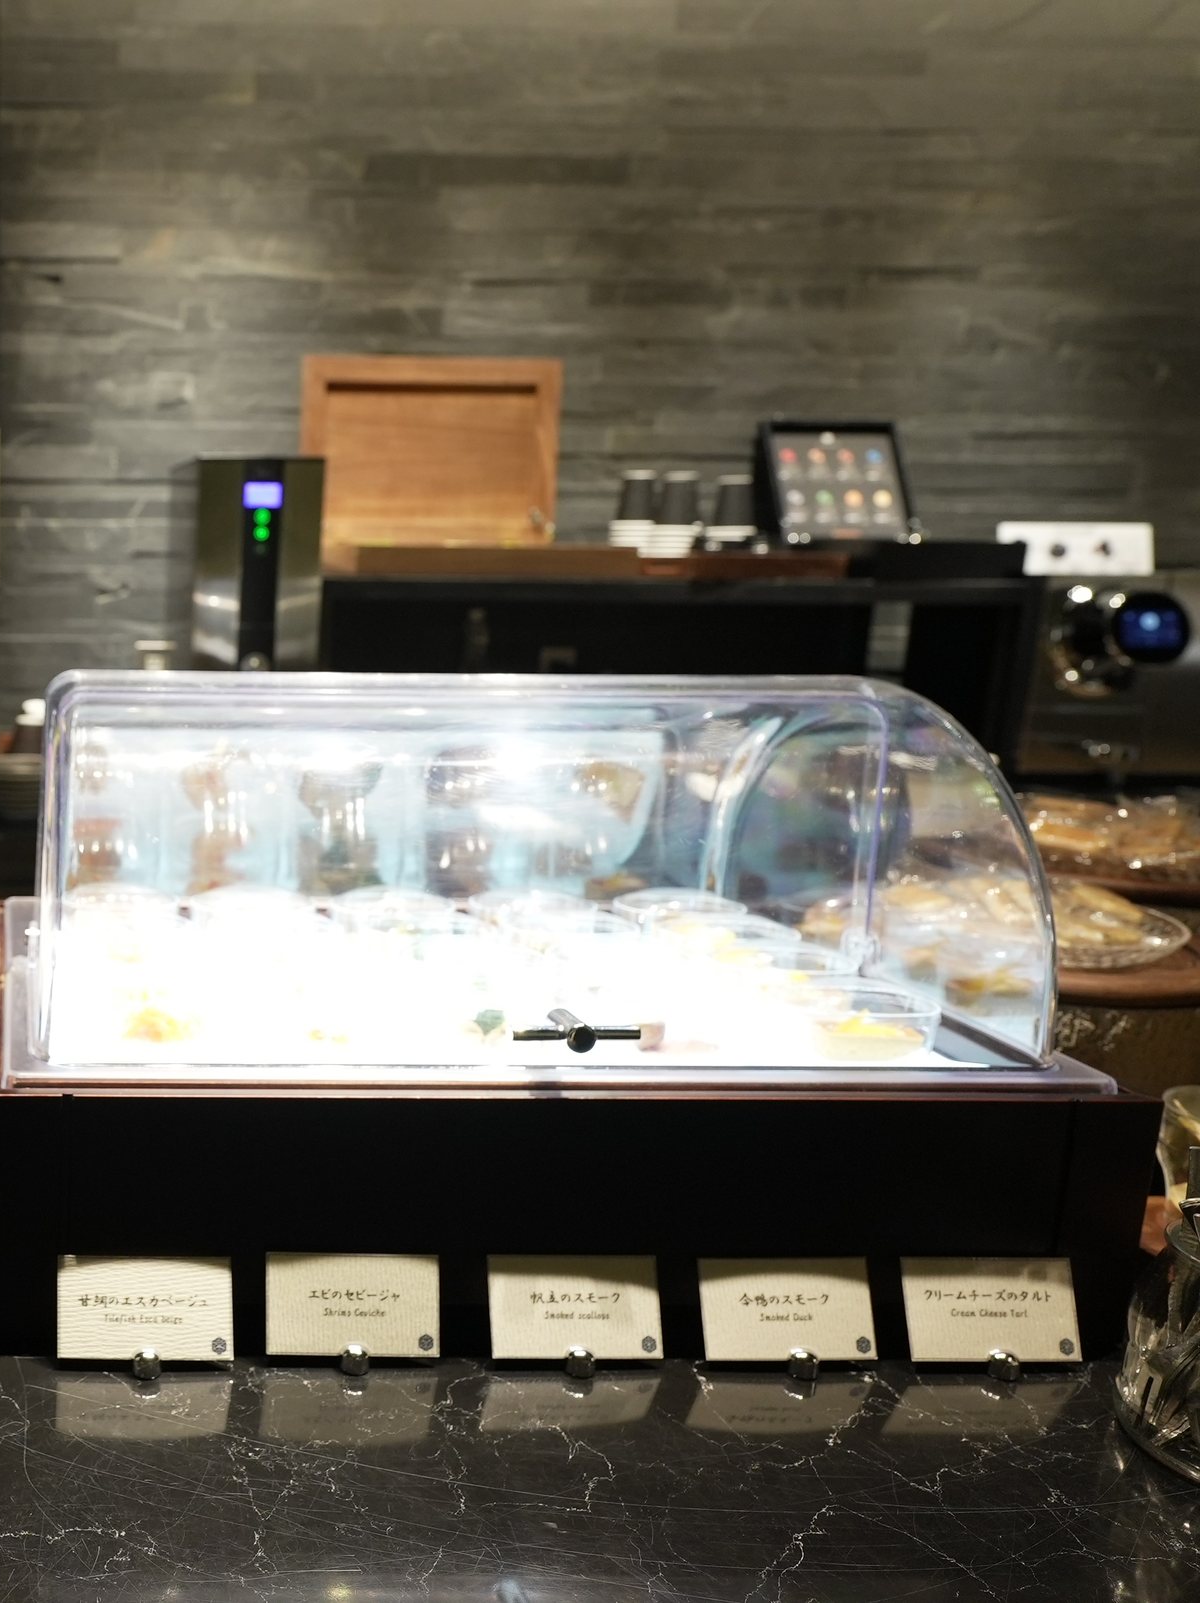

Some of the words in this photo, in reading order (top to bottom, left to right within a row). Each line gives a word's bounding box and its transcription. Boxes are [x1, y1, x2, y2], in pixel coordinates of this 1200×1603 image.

[308, 1288, 401, 1302] エビのセビージャ
[530, 1290, 621, 1304] 帆立のスモーク
[924, 1288, 1052, 1302] クリームチーズのタルト
[544, 1311, 575, 1320] Smoked
[760, 1313, 790, 1322] Smoked
[793, 1313, 814, 1322] Duck
[979, 1309, 1008, 1318] Cheese
[1010, 1309, 1029, 1319] Tart
